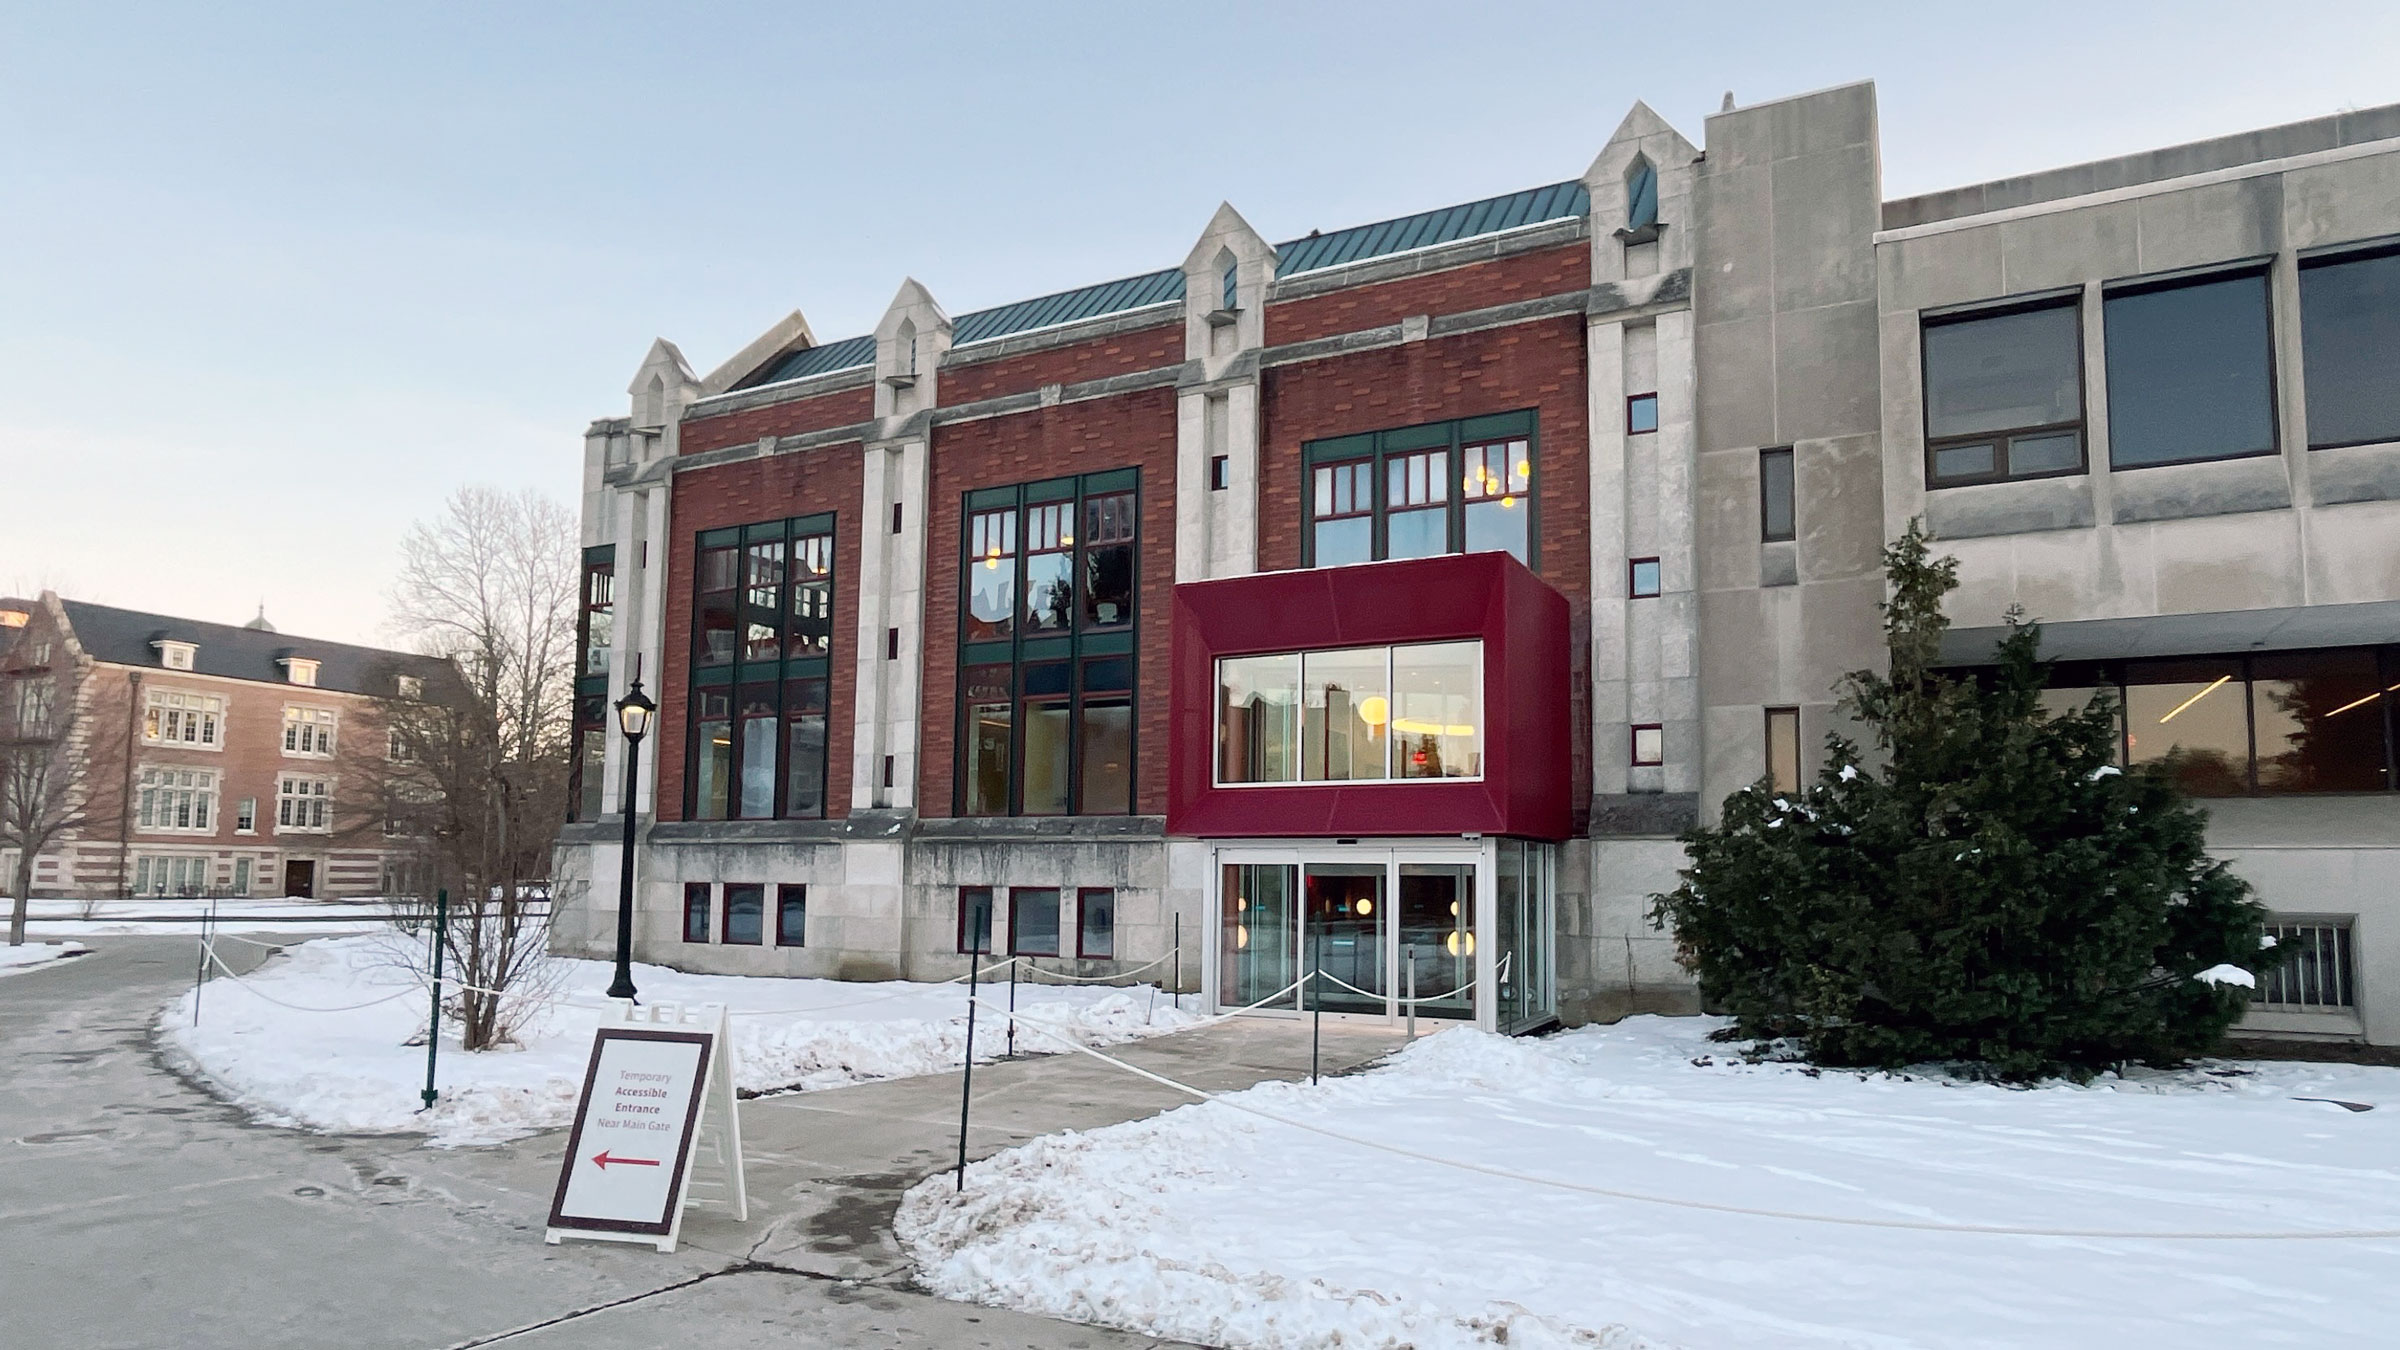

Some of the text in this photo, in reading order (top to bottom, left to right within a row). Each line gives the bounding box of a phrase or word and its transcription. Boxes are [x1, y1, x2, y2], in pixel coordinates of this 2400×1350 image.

[619, 1070, 671, 1084] Temporary
[615, 1086, 667, 1098] Accessible
[615, 1102, 660, 1114] Entrance
[597, 1118, 671, 1132] Near Main Gate
